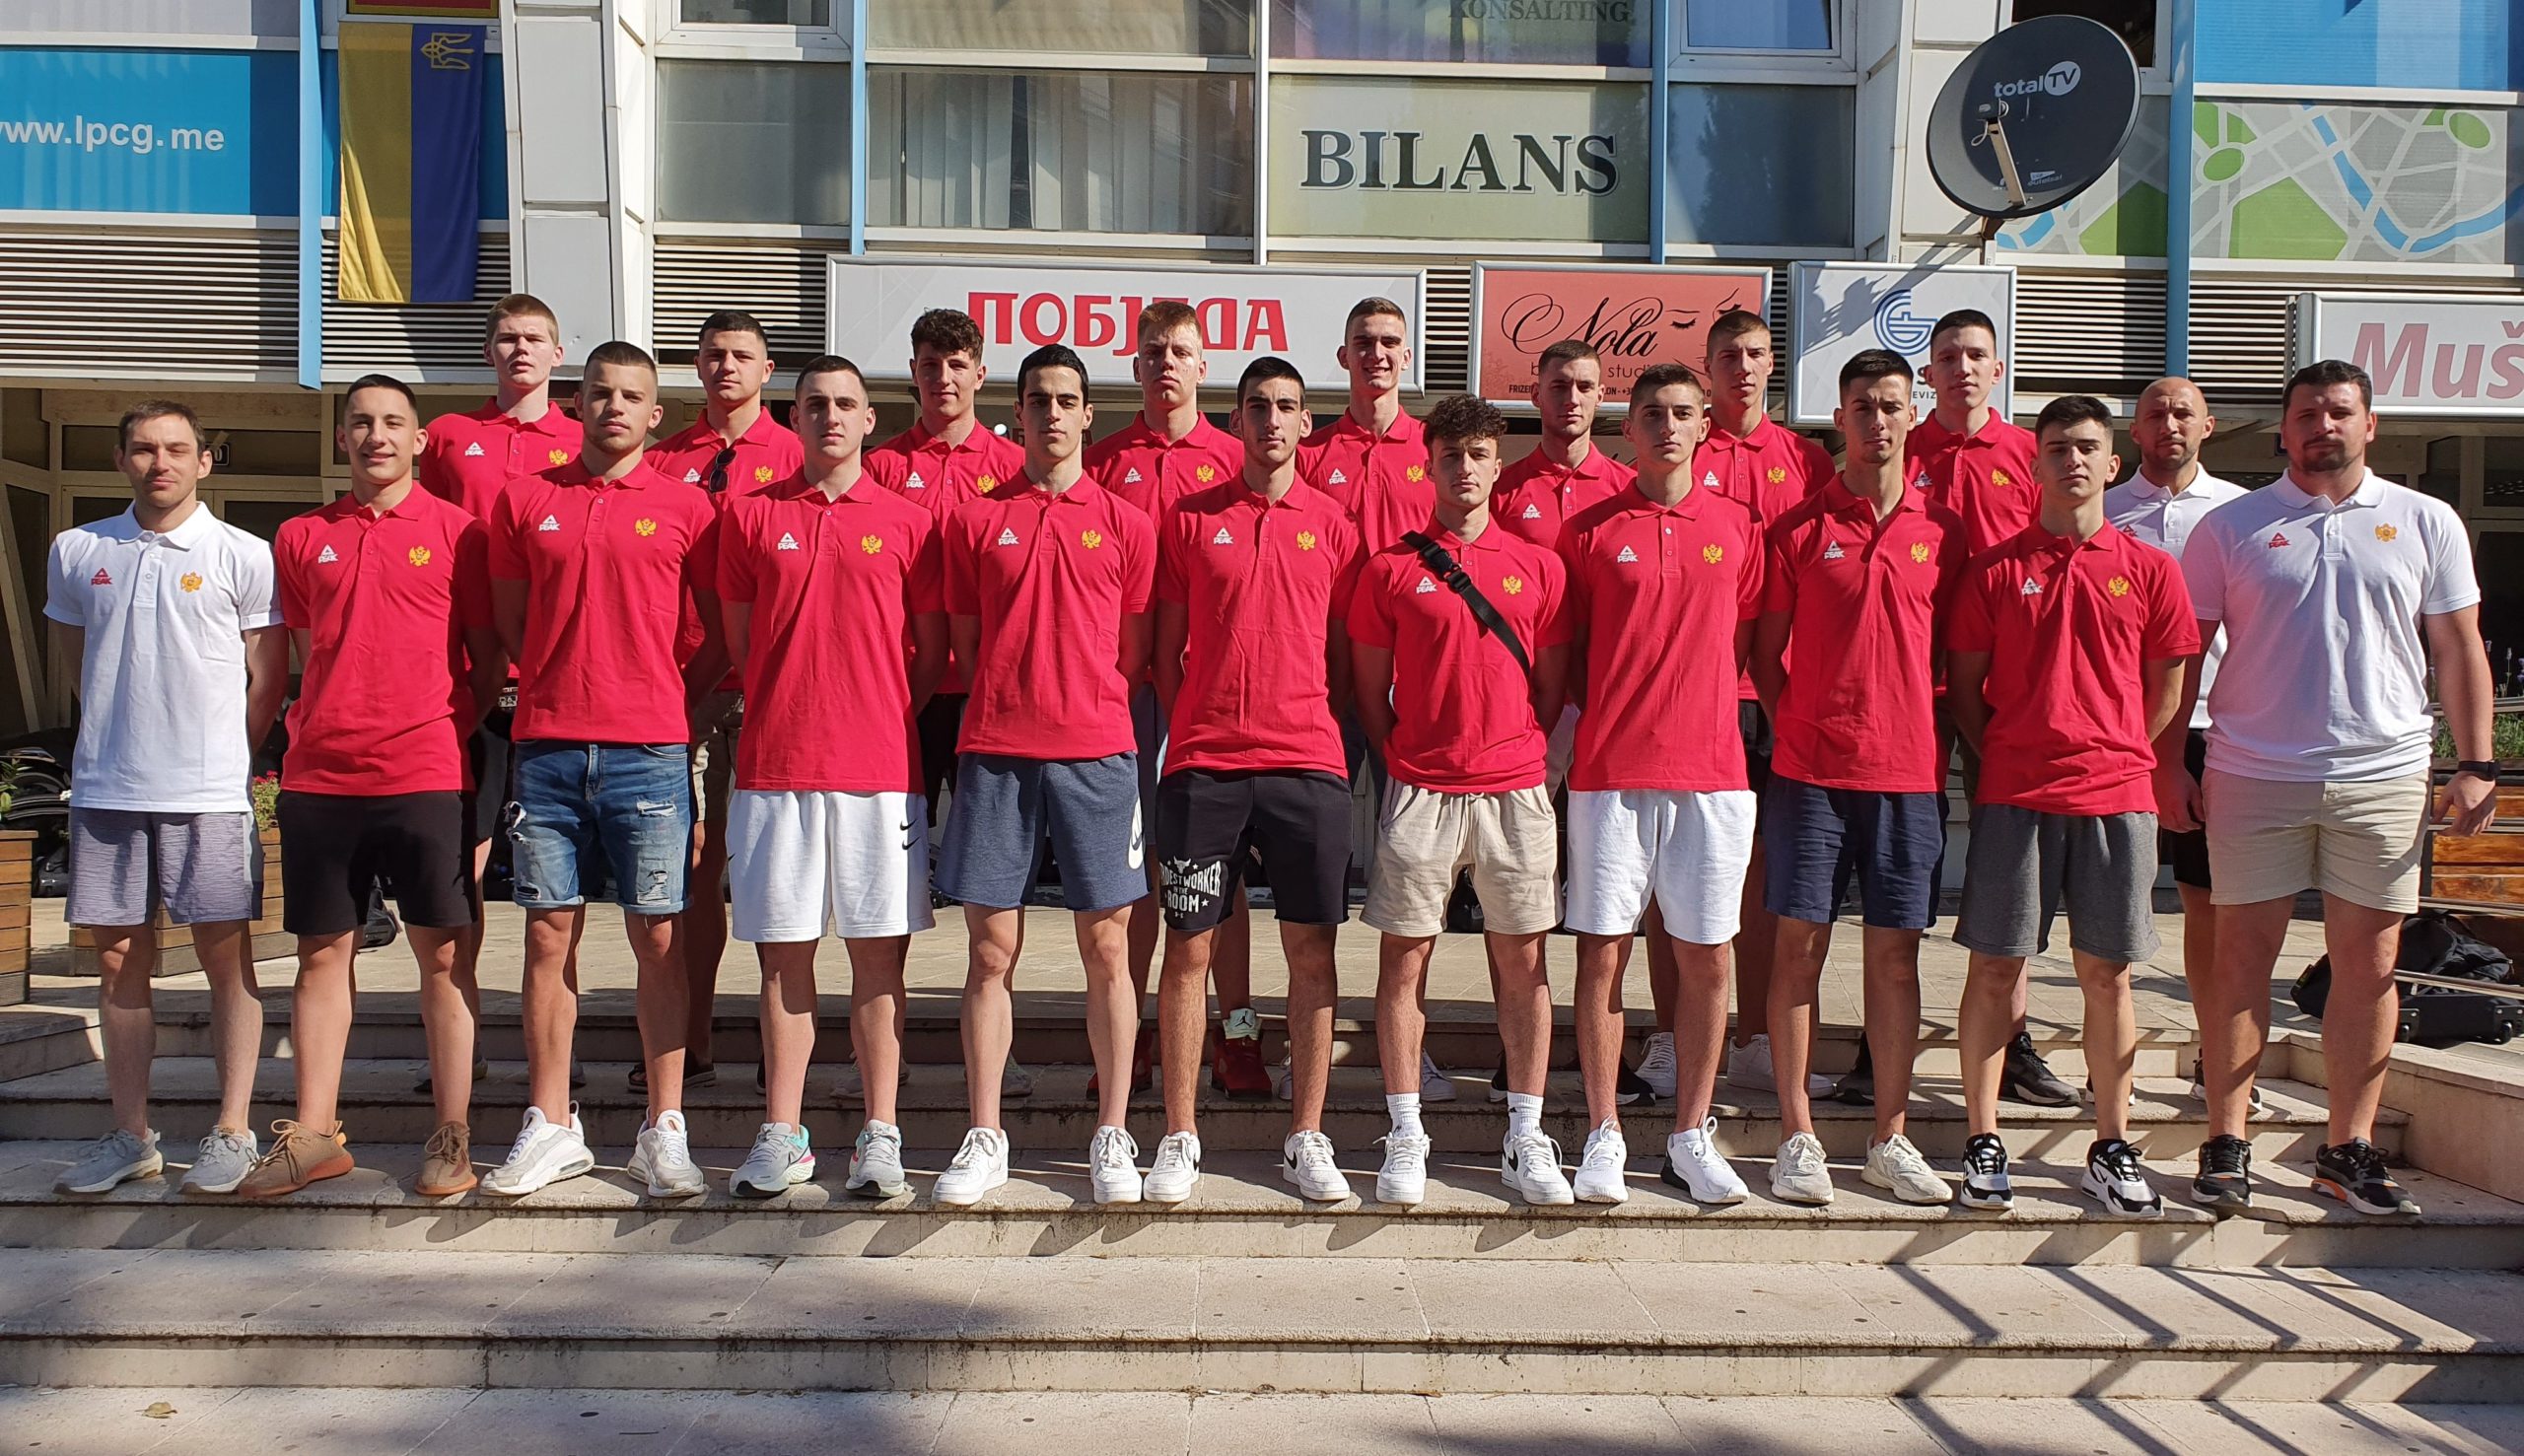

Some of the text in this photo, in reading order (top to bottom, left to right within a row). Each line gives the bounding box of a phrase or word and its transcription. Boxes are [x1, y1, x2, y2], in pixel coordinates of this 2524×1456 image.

[1448, 0, 1623, 23] KONSALTING
[1300, 129, 1619, 195] BILANS
[968, 292, 1289, 357] ПОБЈДА
[1608, 362, 1648, 379] stud
[778, 541, 800, 550] PEAK
[999, 536, 1019, 546] PEAK
[1617, 554, 1639, 563] PEAK
[1824, 550, 1846, 560] PEAK
[1416, 584, 1437, 593] PEAK
[1183, 860, 1222, 897] WORKER
[1167, 889, 1200, 913] ROOM
